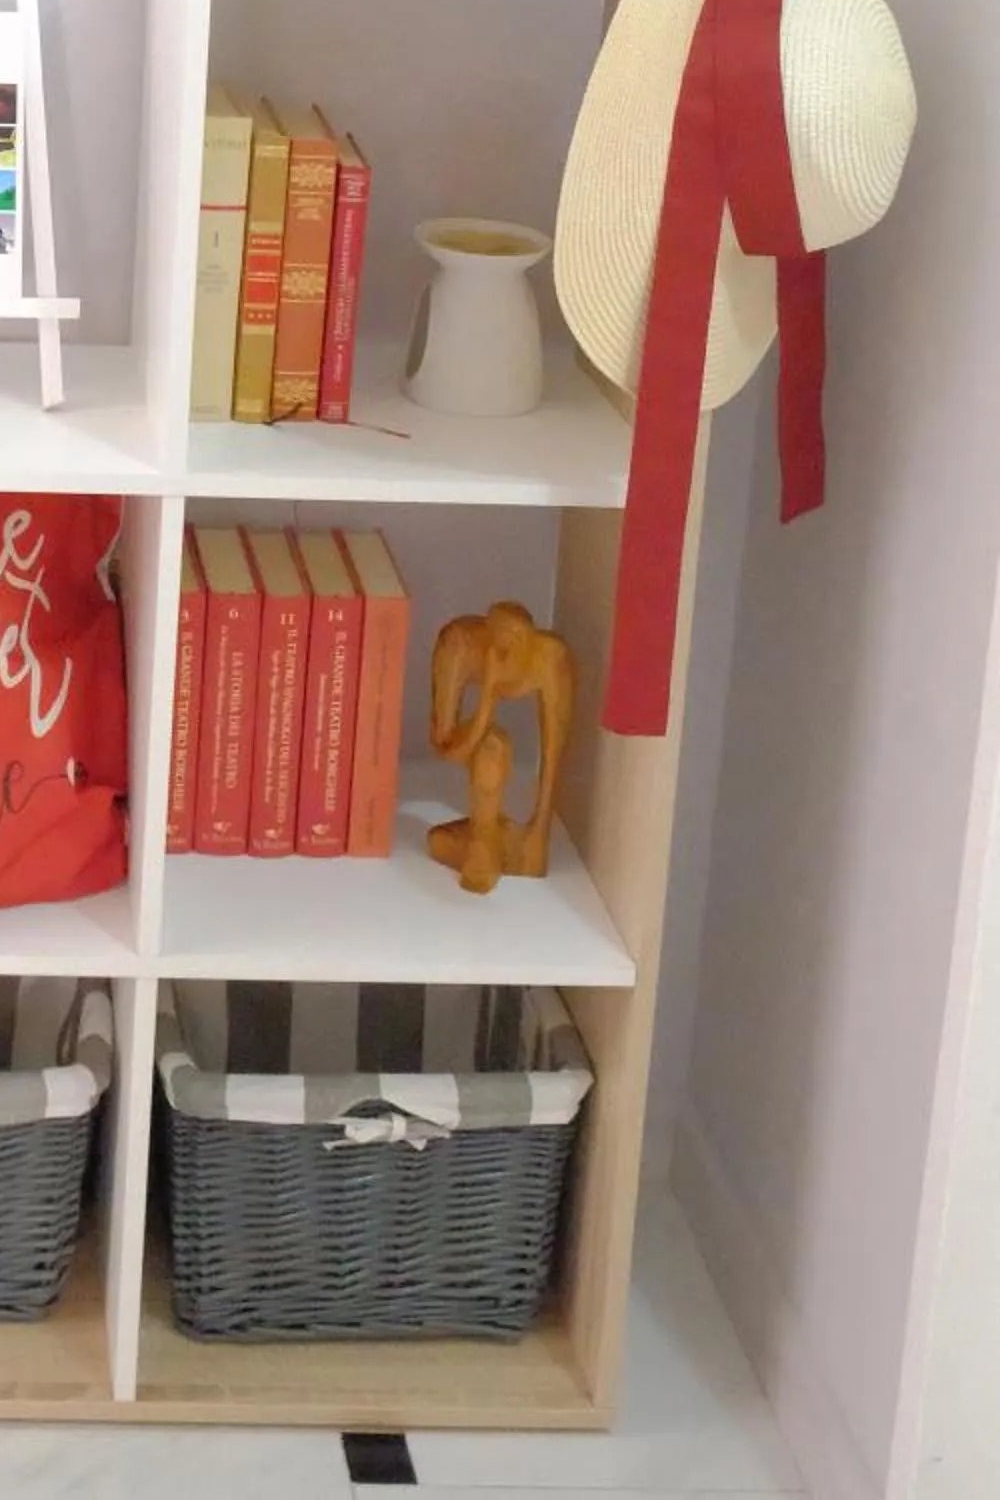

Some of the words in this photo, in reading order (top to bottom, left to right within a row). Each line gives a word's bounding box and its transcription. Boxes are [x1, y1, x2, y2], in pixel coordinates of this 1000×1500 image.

[178, 644, 191, 697] GRANDE
[229, 651, 244, 667] LA
[282, 641, 296, 683] TEATRO
[330, 643, 346, 695] GRANDE
[175, 700, 188, 745] TEATRO
[327, 699, 343, 746] TEATRO
[223, 742, 240, 789] TEATRO
